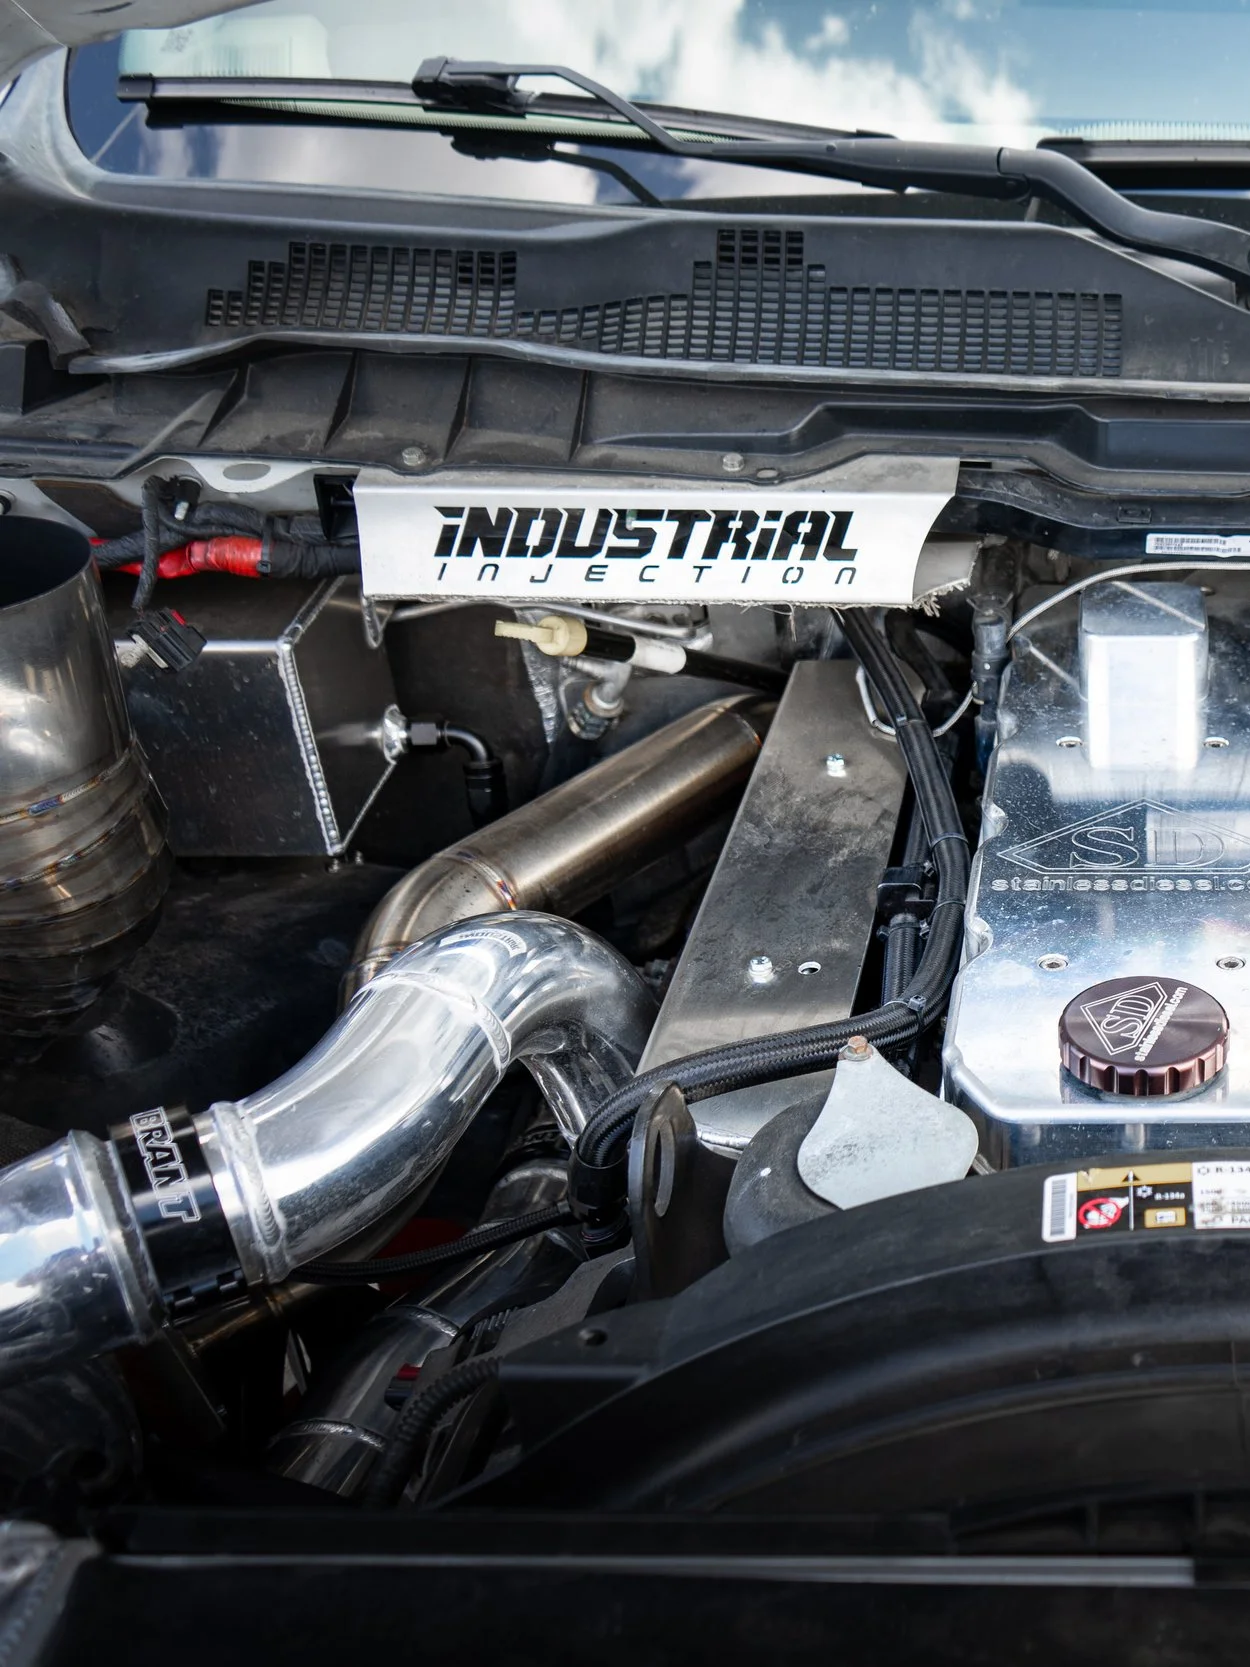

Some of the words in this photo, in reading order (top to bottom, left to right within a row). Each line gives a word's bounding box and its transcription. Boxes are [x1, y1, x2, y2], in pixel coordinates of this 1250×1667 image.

[1070, 826, 1225, 868] SD
[1100, 995, 1155, 1039] SD
[129, 1106, 201, 1223] BRANT
